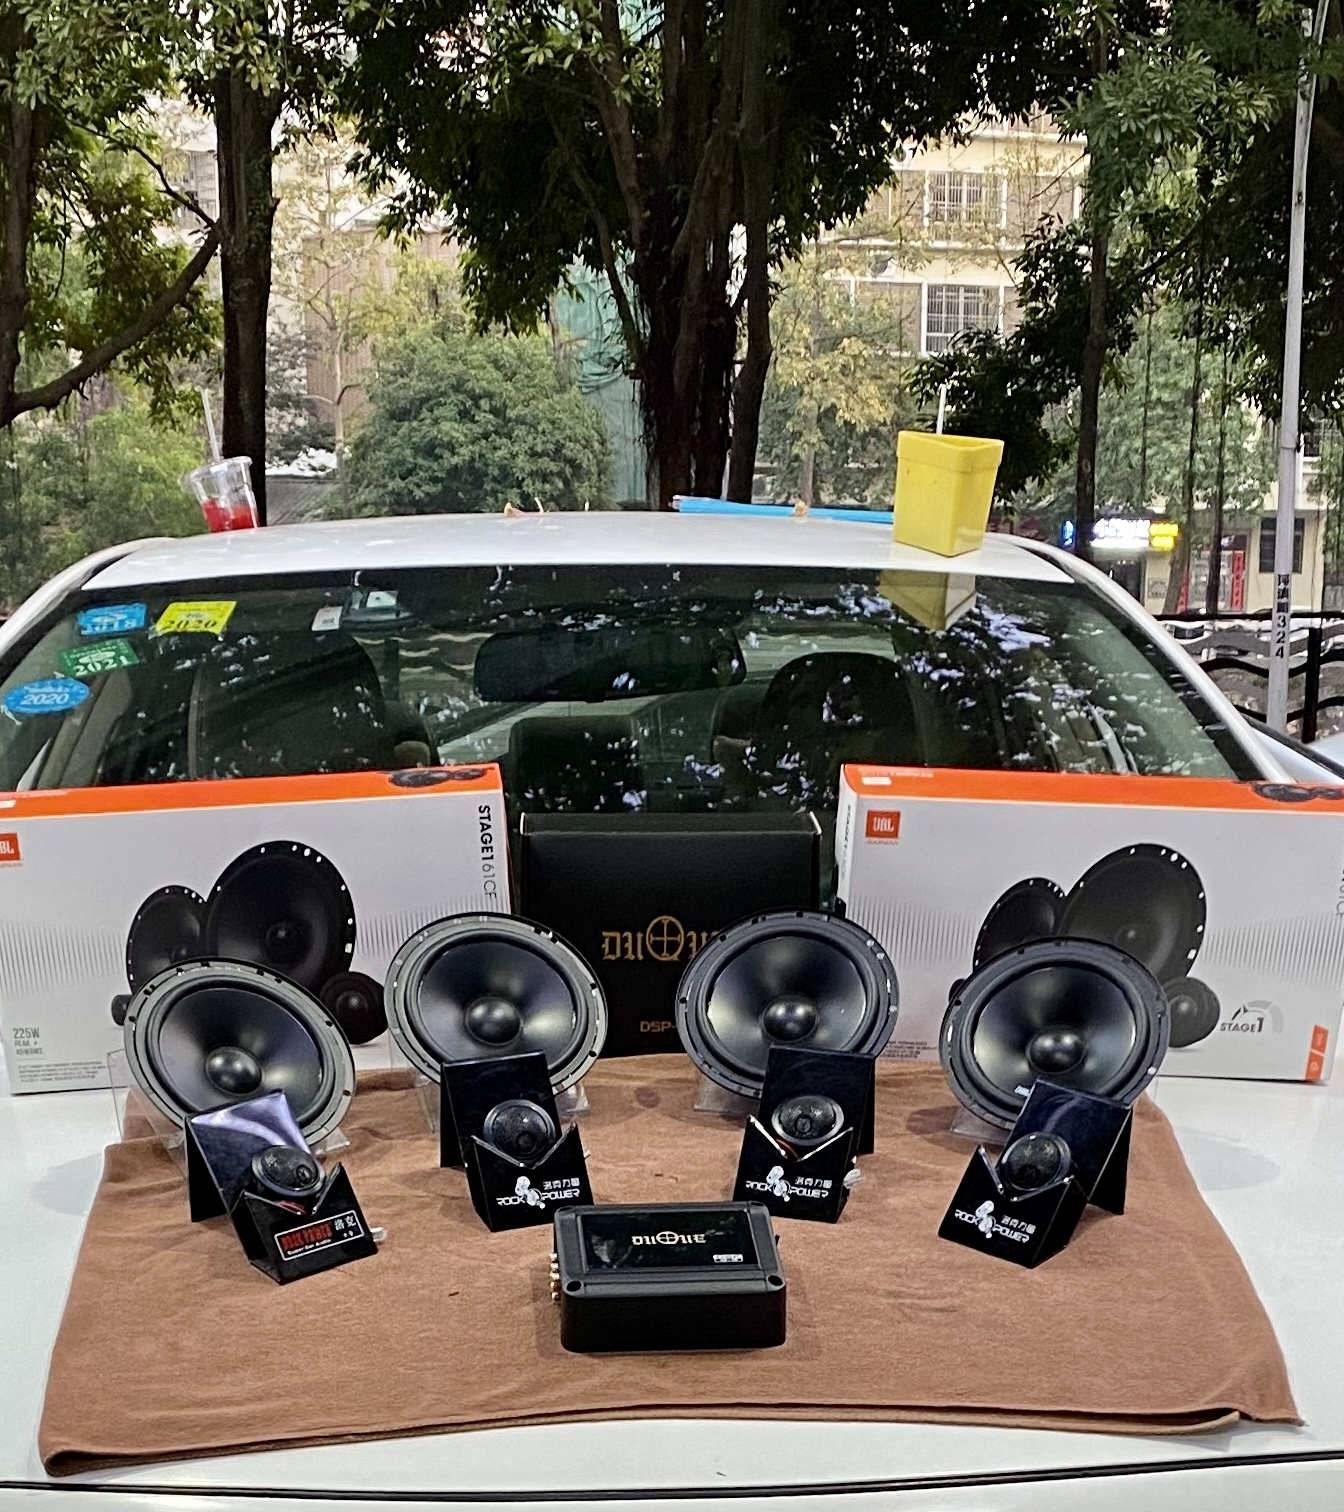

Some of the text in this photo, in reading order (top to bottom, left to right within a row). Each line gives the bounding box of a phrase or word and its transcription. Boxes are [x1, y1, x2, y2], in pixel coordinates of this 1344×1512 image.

[159, 619, 217, 633] 2020
[72, 655, 130, 677] 2021
[19, 692, 70, 706] 2020
[1219, 1017, 1264, 1033] STAGE1
[541, 1189, 580, 1201] POWER
